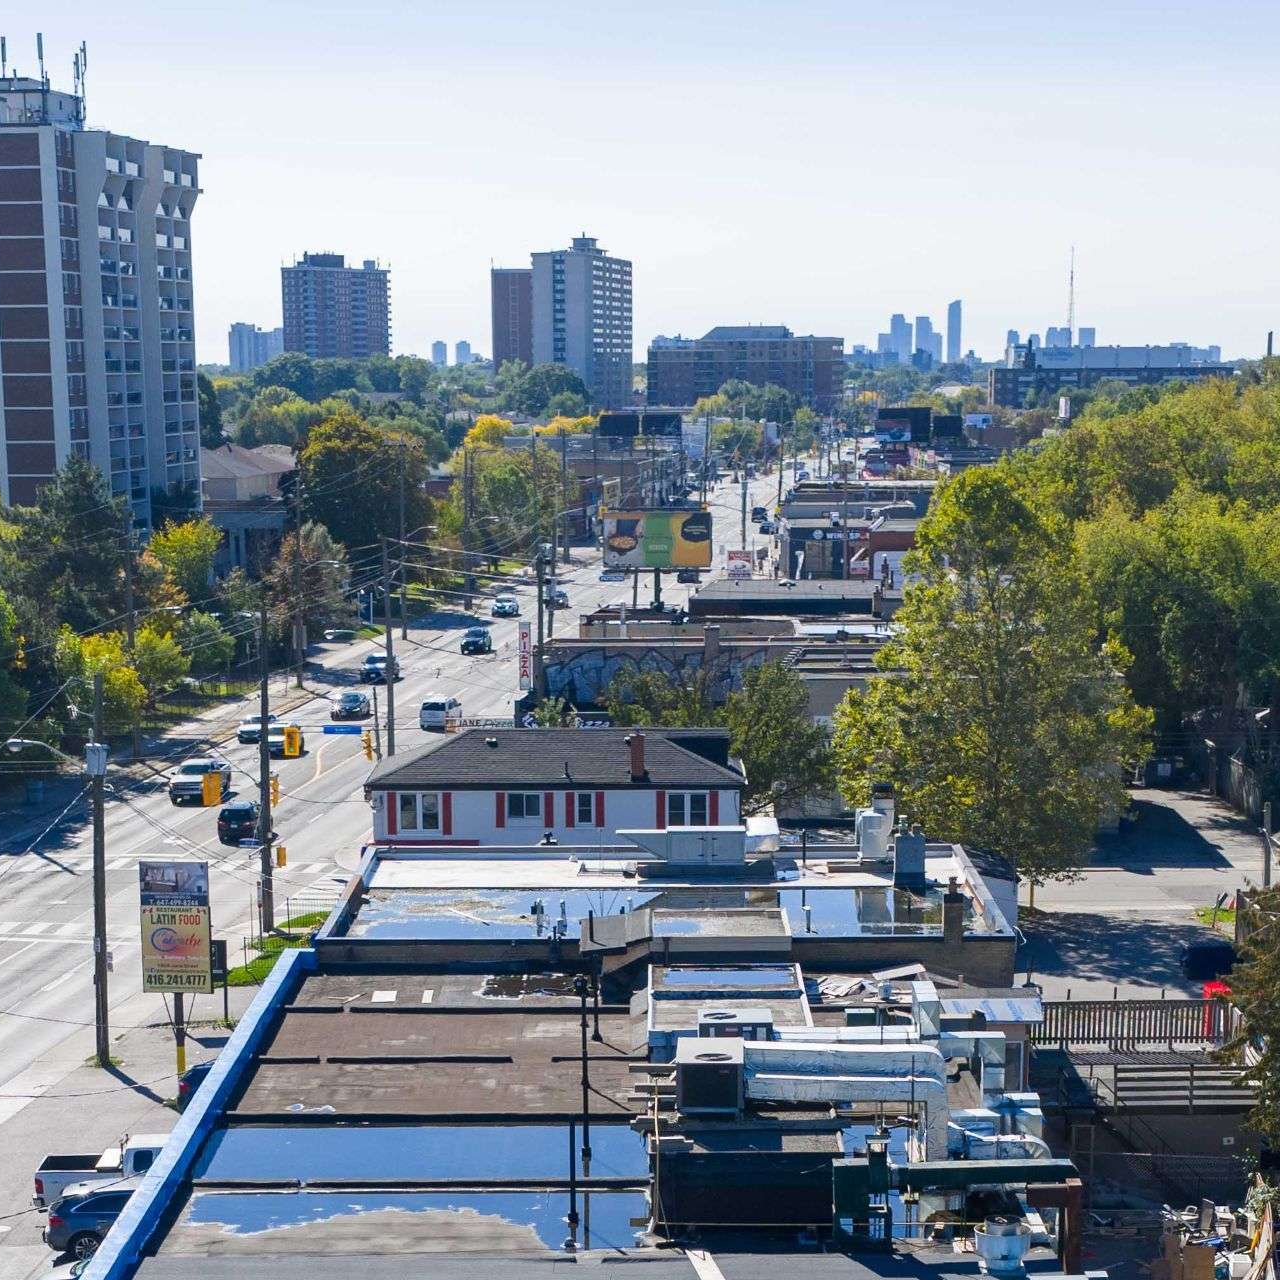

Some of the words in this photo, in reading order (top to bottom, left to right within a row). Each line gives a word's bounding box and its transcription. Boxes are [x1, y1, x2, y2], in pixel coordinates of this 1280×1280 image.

[521, 631, 529, 678] PIZZA
[151, 914, 176, 925] LATIN
[178, 914, 201, 925] FOOD
[147, 974, 206, 985] 416.241.4777
